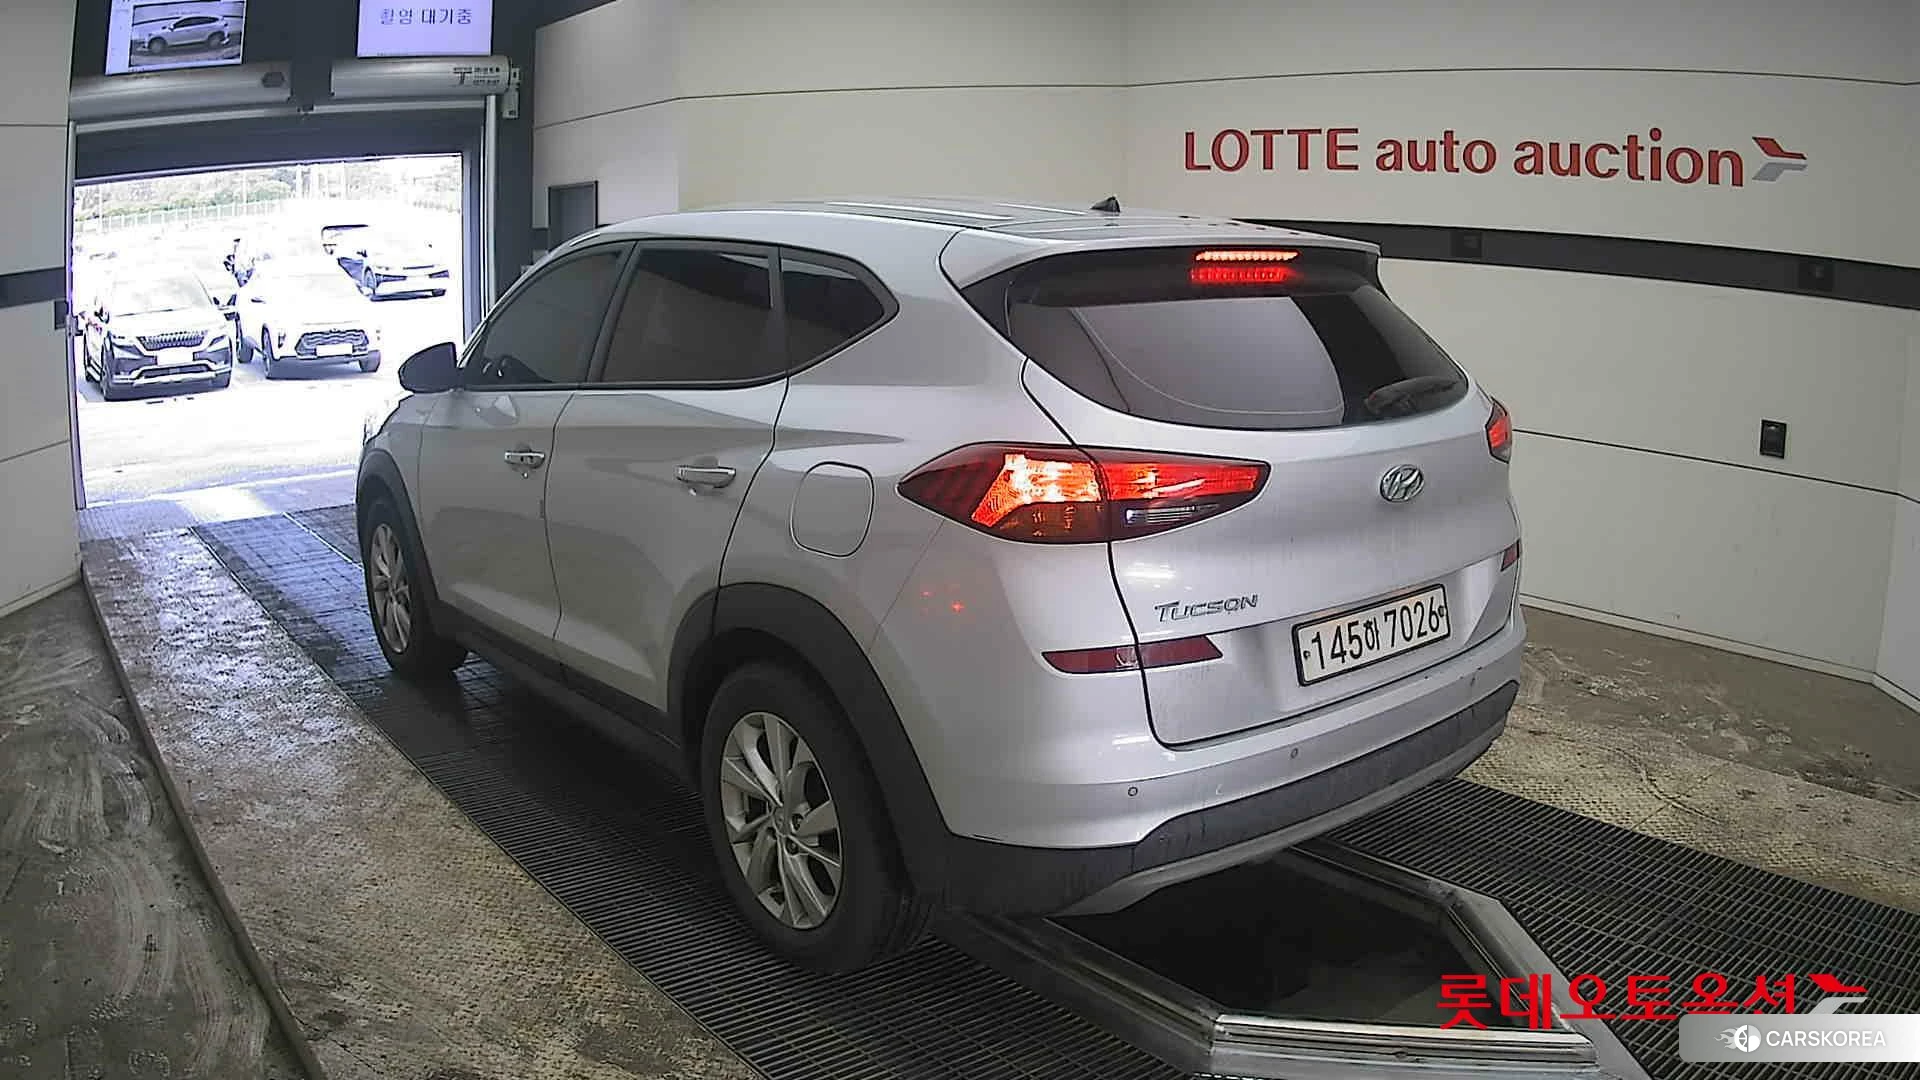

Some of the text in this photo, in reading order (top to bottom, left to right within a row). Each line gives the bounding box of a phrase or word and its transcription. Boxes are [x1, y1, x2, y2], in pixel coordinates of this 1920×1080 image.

[421, 8, 472, 25] 대기중
[1183, 127, 1744, 187] LOTTE auto auction
[1154, 594, 1259, 622] TUCSON
[1383, 596, 1441, 649] 7026
